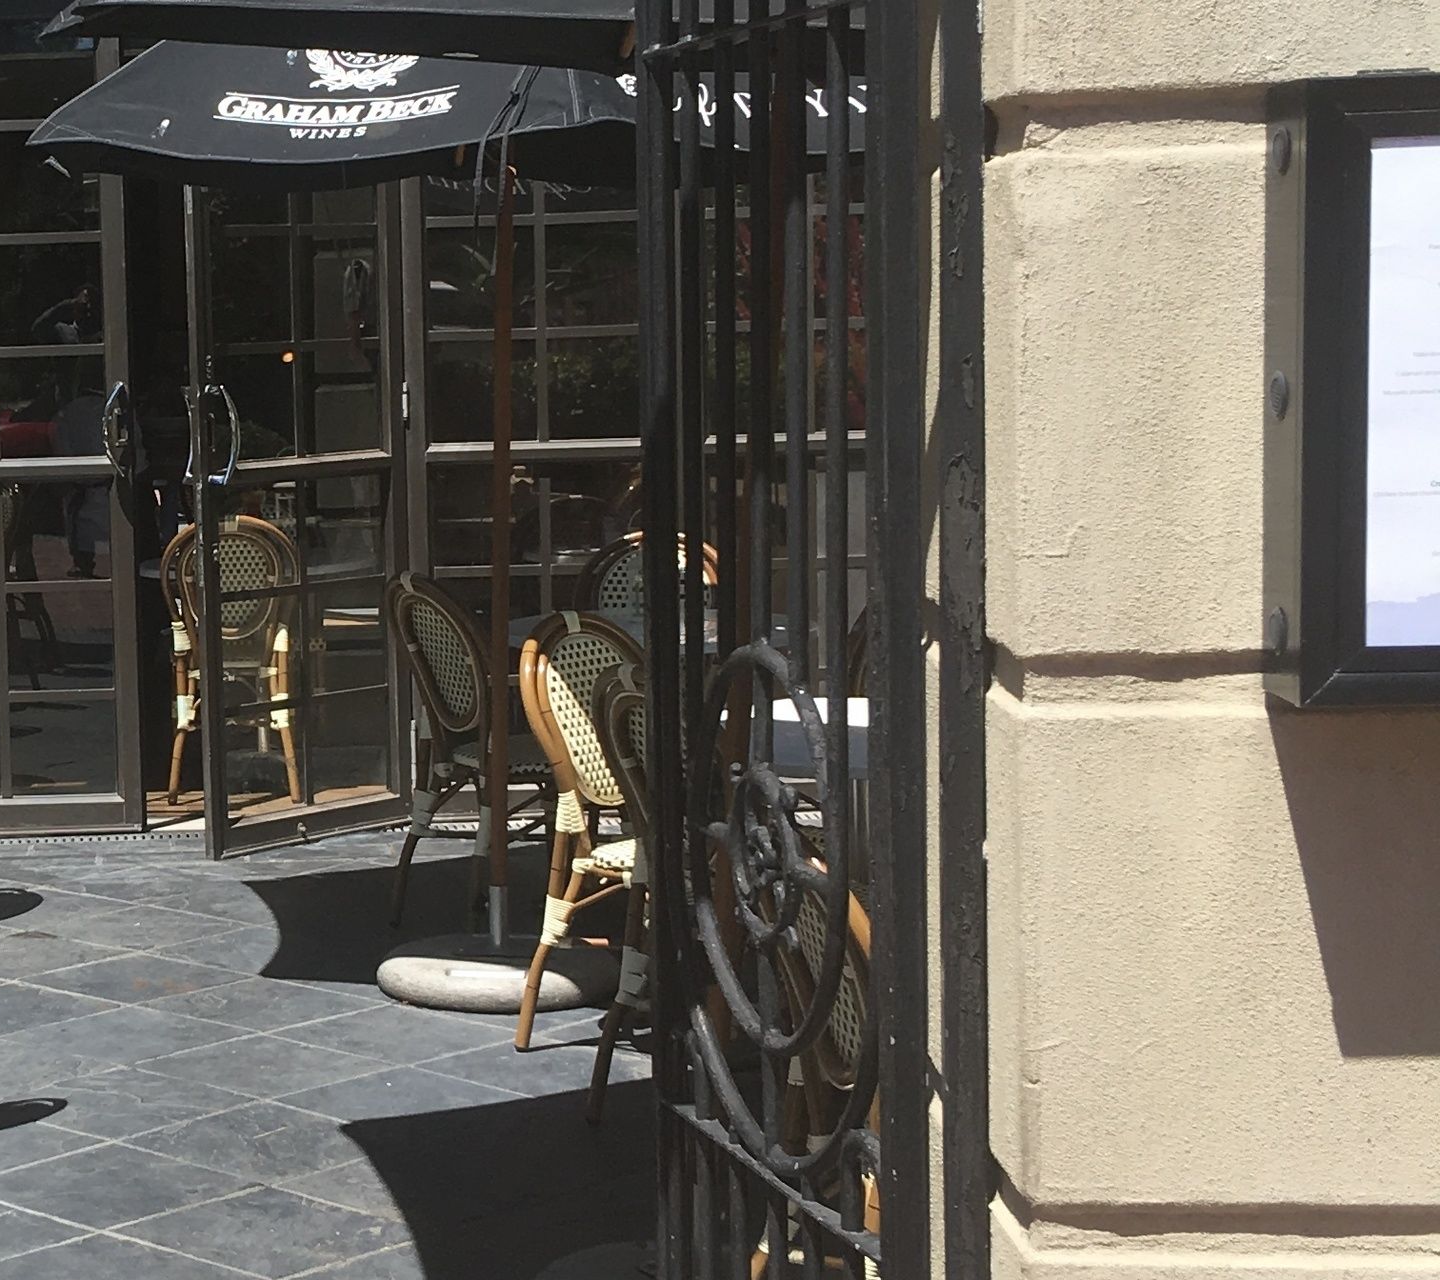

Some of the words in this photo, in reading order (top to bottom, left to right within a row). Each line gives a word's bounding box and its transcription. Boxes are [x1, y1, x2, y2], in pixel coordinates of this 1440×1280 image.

[217, 96, 365, 123] GRAHAM
[362, 91, 458, 122] BECK
[289, 126, 368, 140] WINES
